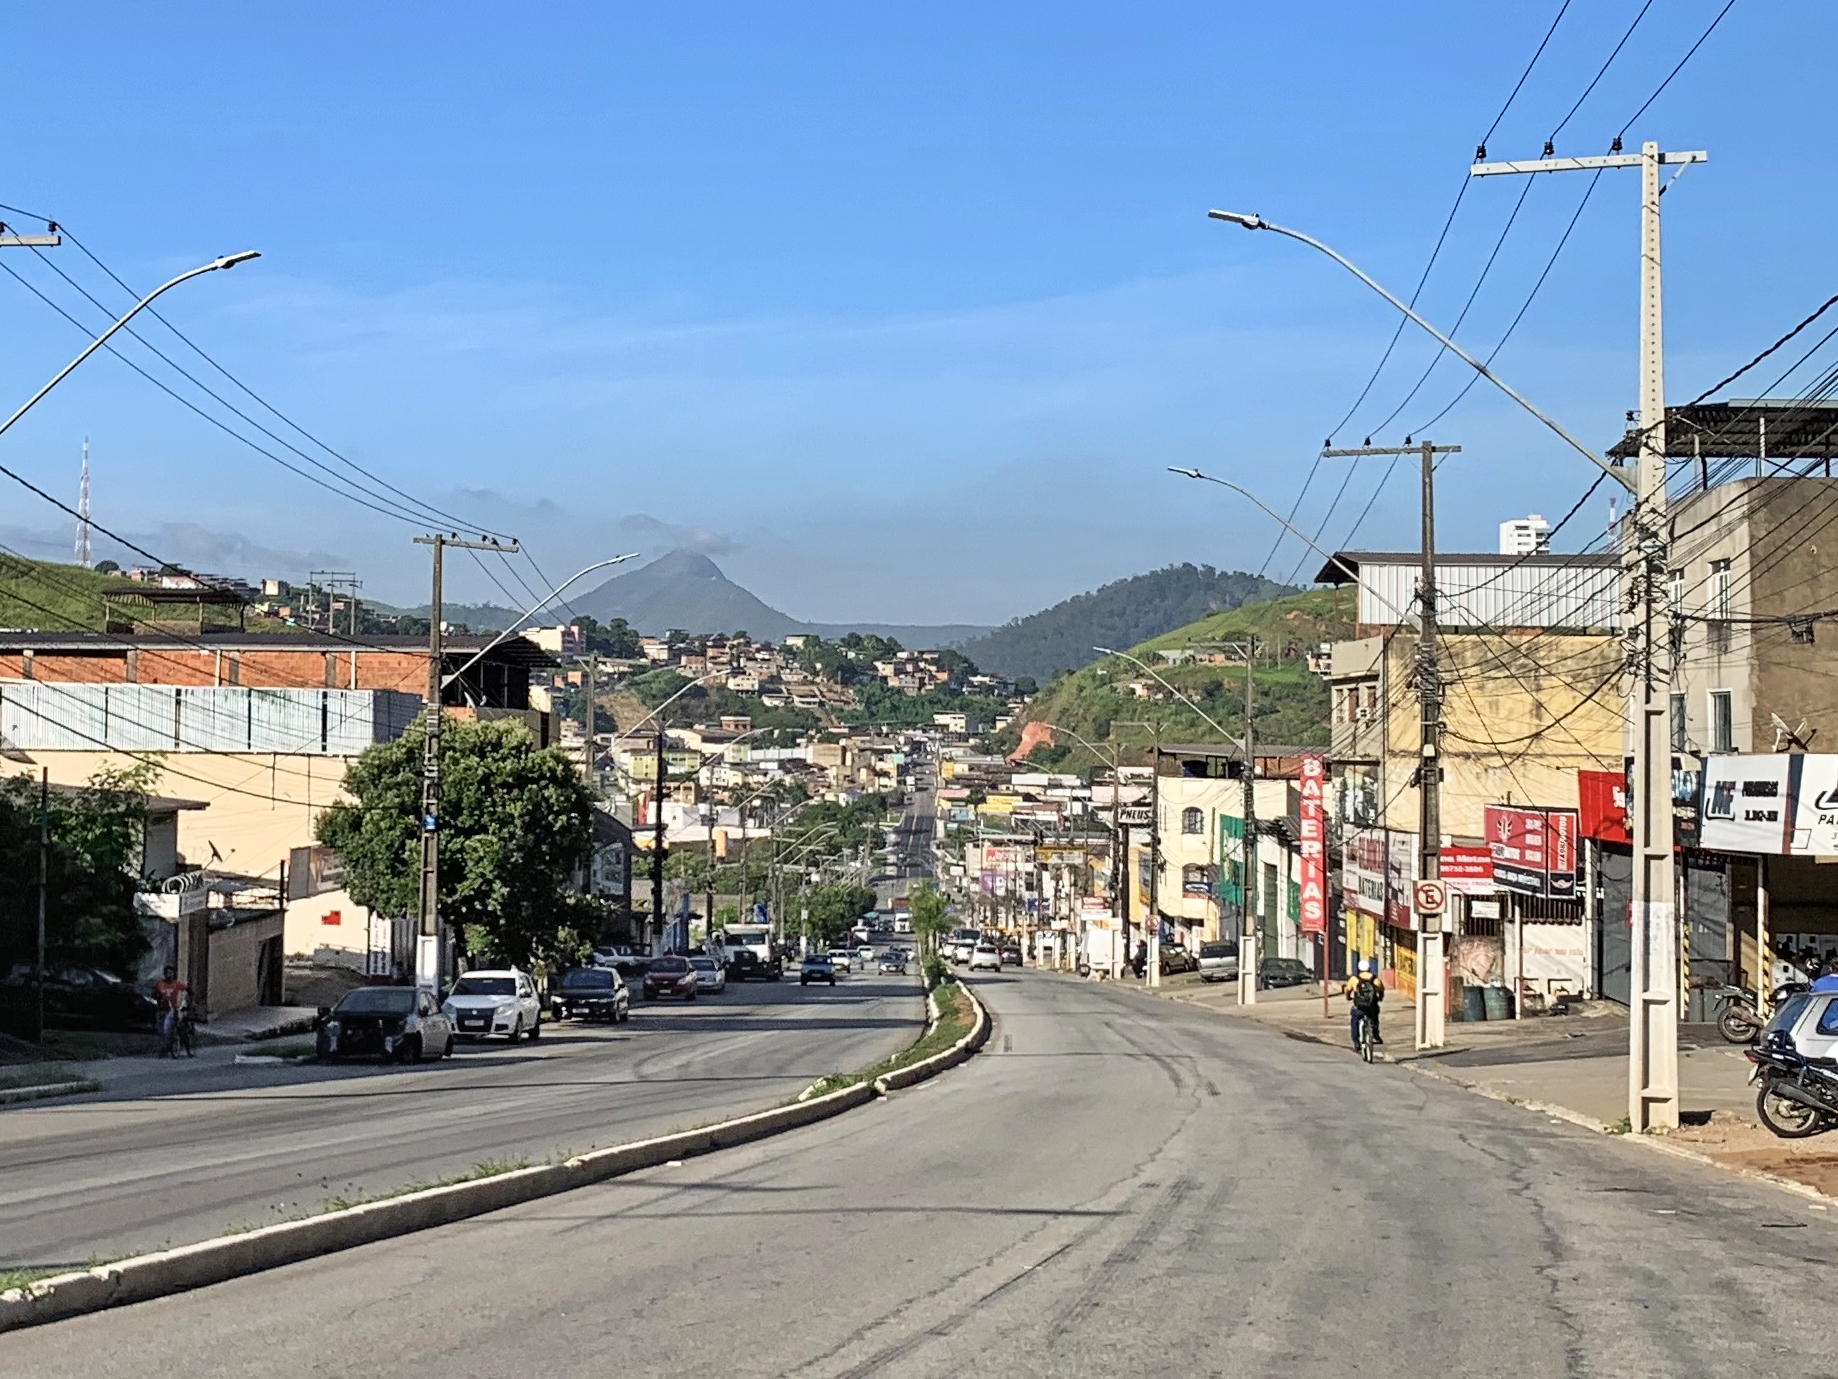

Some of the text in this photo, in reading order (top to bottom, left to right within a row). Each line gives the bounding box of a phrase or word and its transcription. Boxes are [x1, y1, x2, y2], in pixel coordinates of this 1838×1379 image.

[1119, 808, 1150, 820] PNEUS
[1818, 814, 1838, 825] PA
[1301, 758, 1322, 919] BATERIAS
[1425, 889, 1435, 904] E
